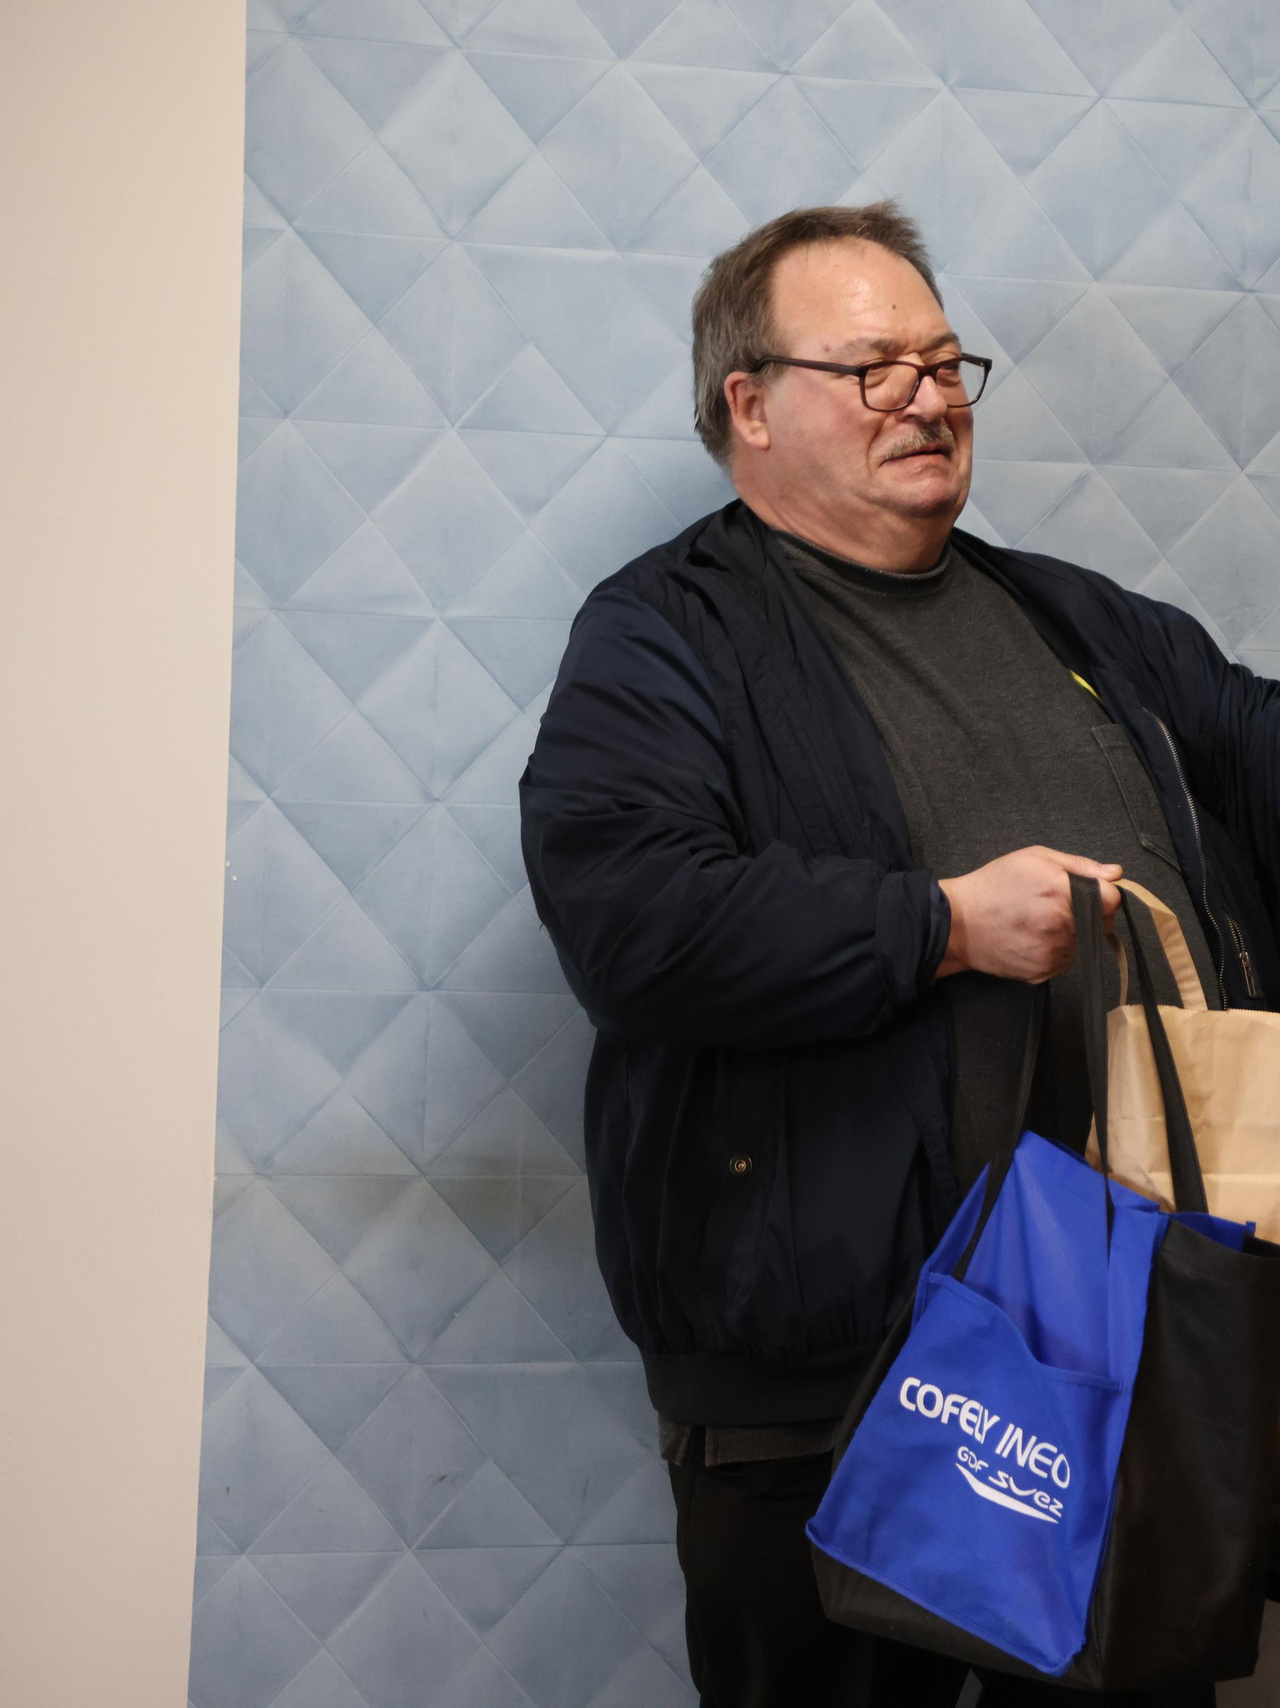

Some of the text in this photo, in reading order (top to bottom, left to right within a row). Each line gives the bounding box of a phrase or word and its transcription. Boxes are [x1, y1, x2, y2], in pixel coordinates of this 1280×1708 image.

[900, 1376, 1071, 1489] COFELY INEO
[957, 1446, 989, 1472] GDF
